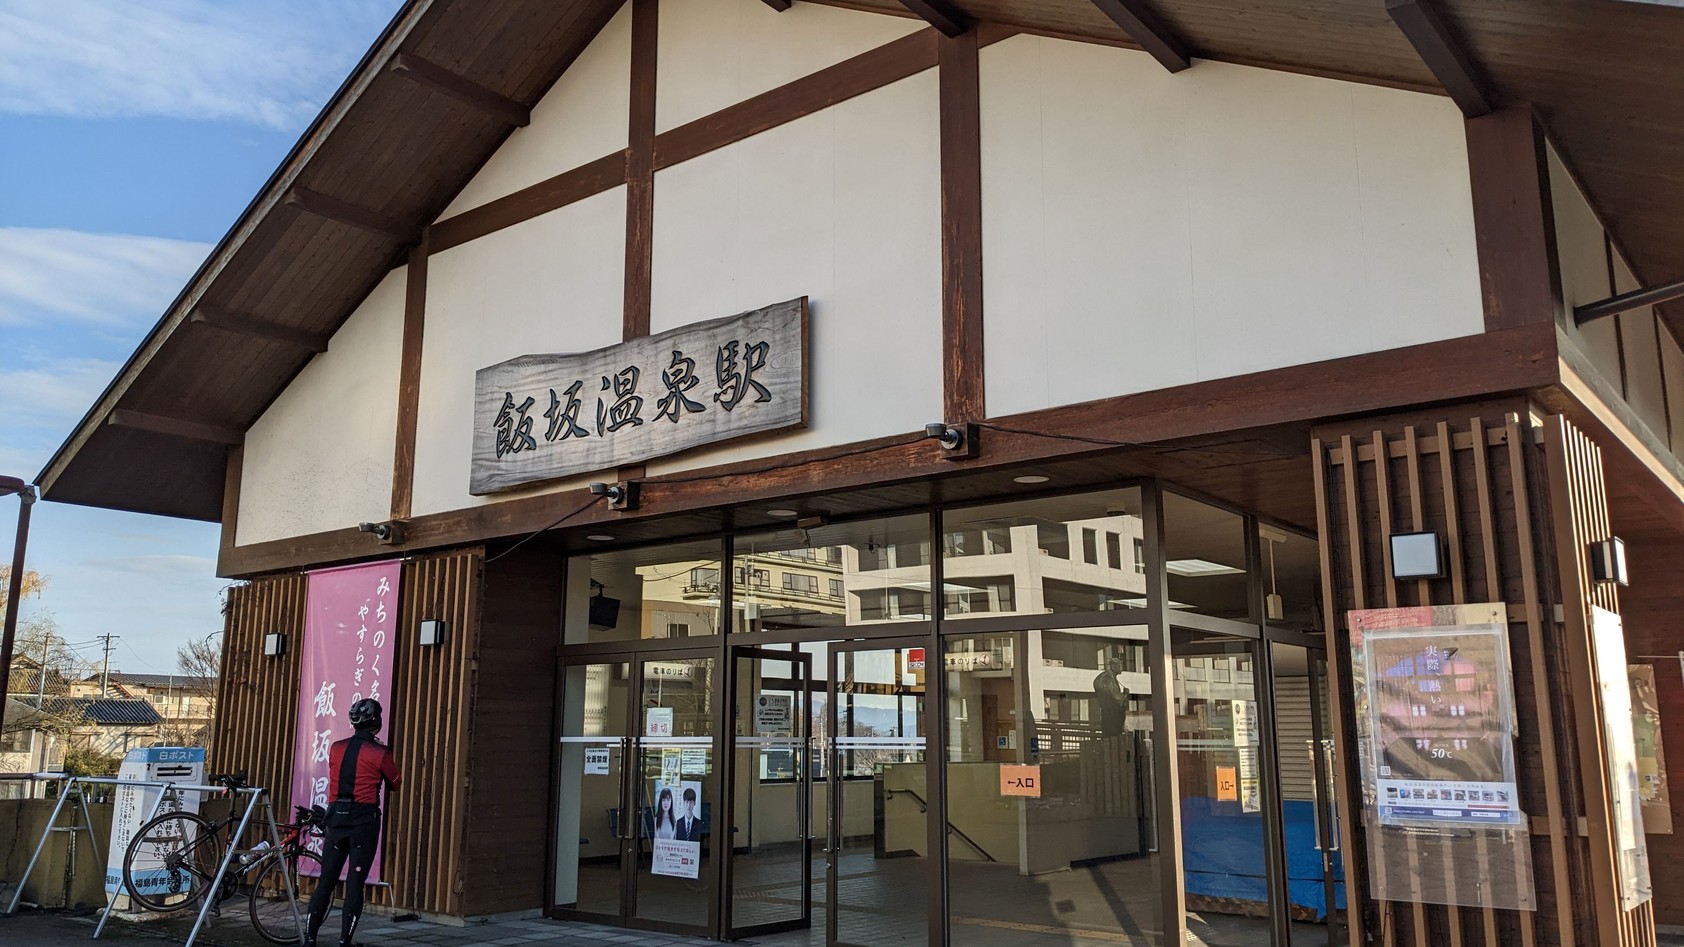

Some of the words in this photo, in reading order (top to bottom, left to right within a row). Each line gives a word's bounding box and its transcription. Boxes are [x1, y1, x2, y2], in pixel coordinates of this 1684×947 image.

[493, 340, 772, 459] 飯坂温泉駅
[350, 598, 370, 728] やすらぎの
[160, 751, 194, 760] 白ポスト
[586, 755, 608, 763] 全面禁煙
[1016, 777, 1034, 788] 入口
[1220, 781, 1230, 790] 入口
[135, 875, 191, 888] 福島青年会所
